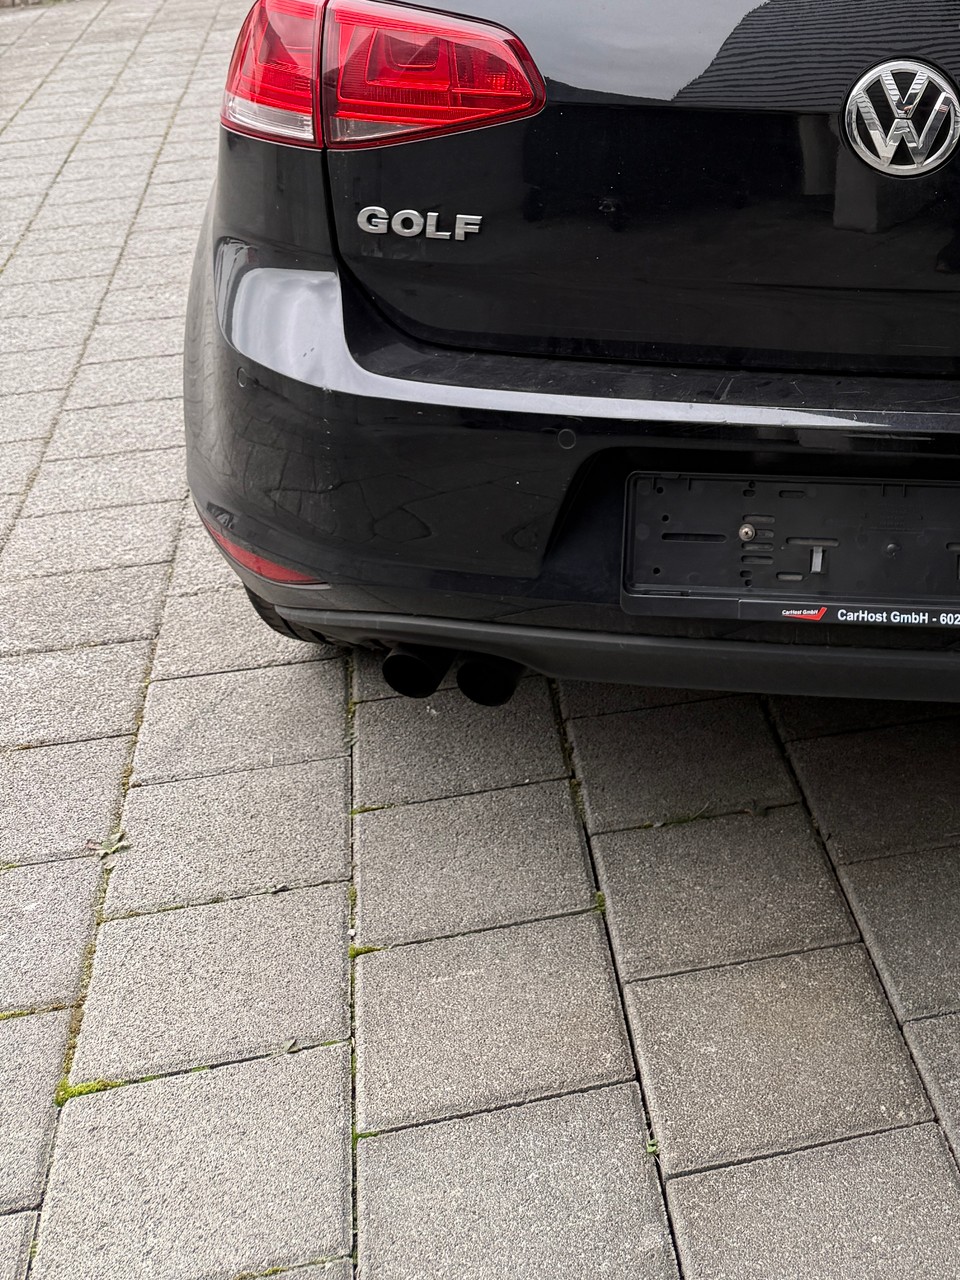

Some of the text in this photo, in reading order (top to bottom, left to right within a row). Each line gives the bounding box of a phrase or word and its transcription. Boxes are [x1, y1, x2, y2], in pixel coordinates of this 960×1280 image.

[846, 61, 960, 176] VW
[357, 206, 483, 241] GOLF
[837, 609, 888, 622] CarHost
[890, 611, 929, 624] GmbH
